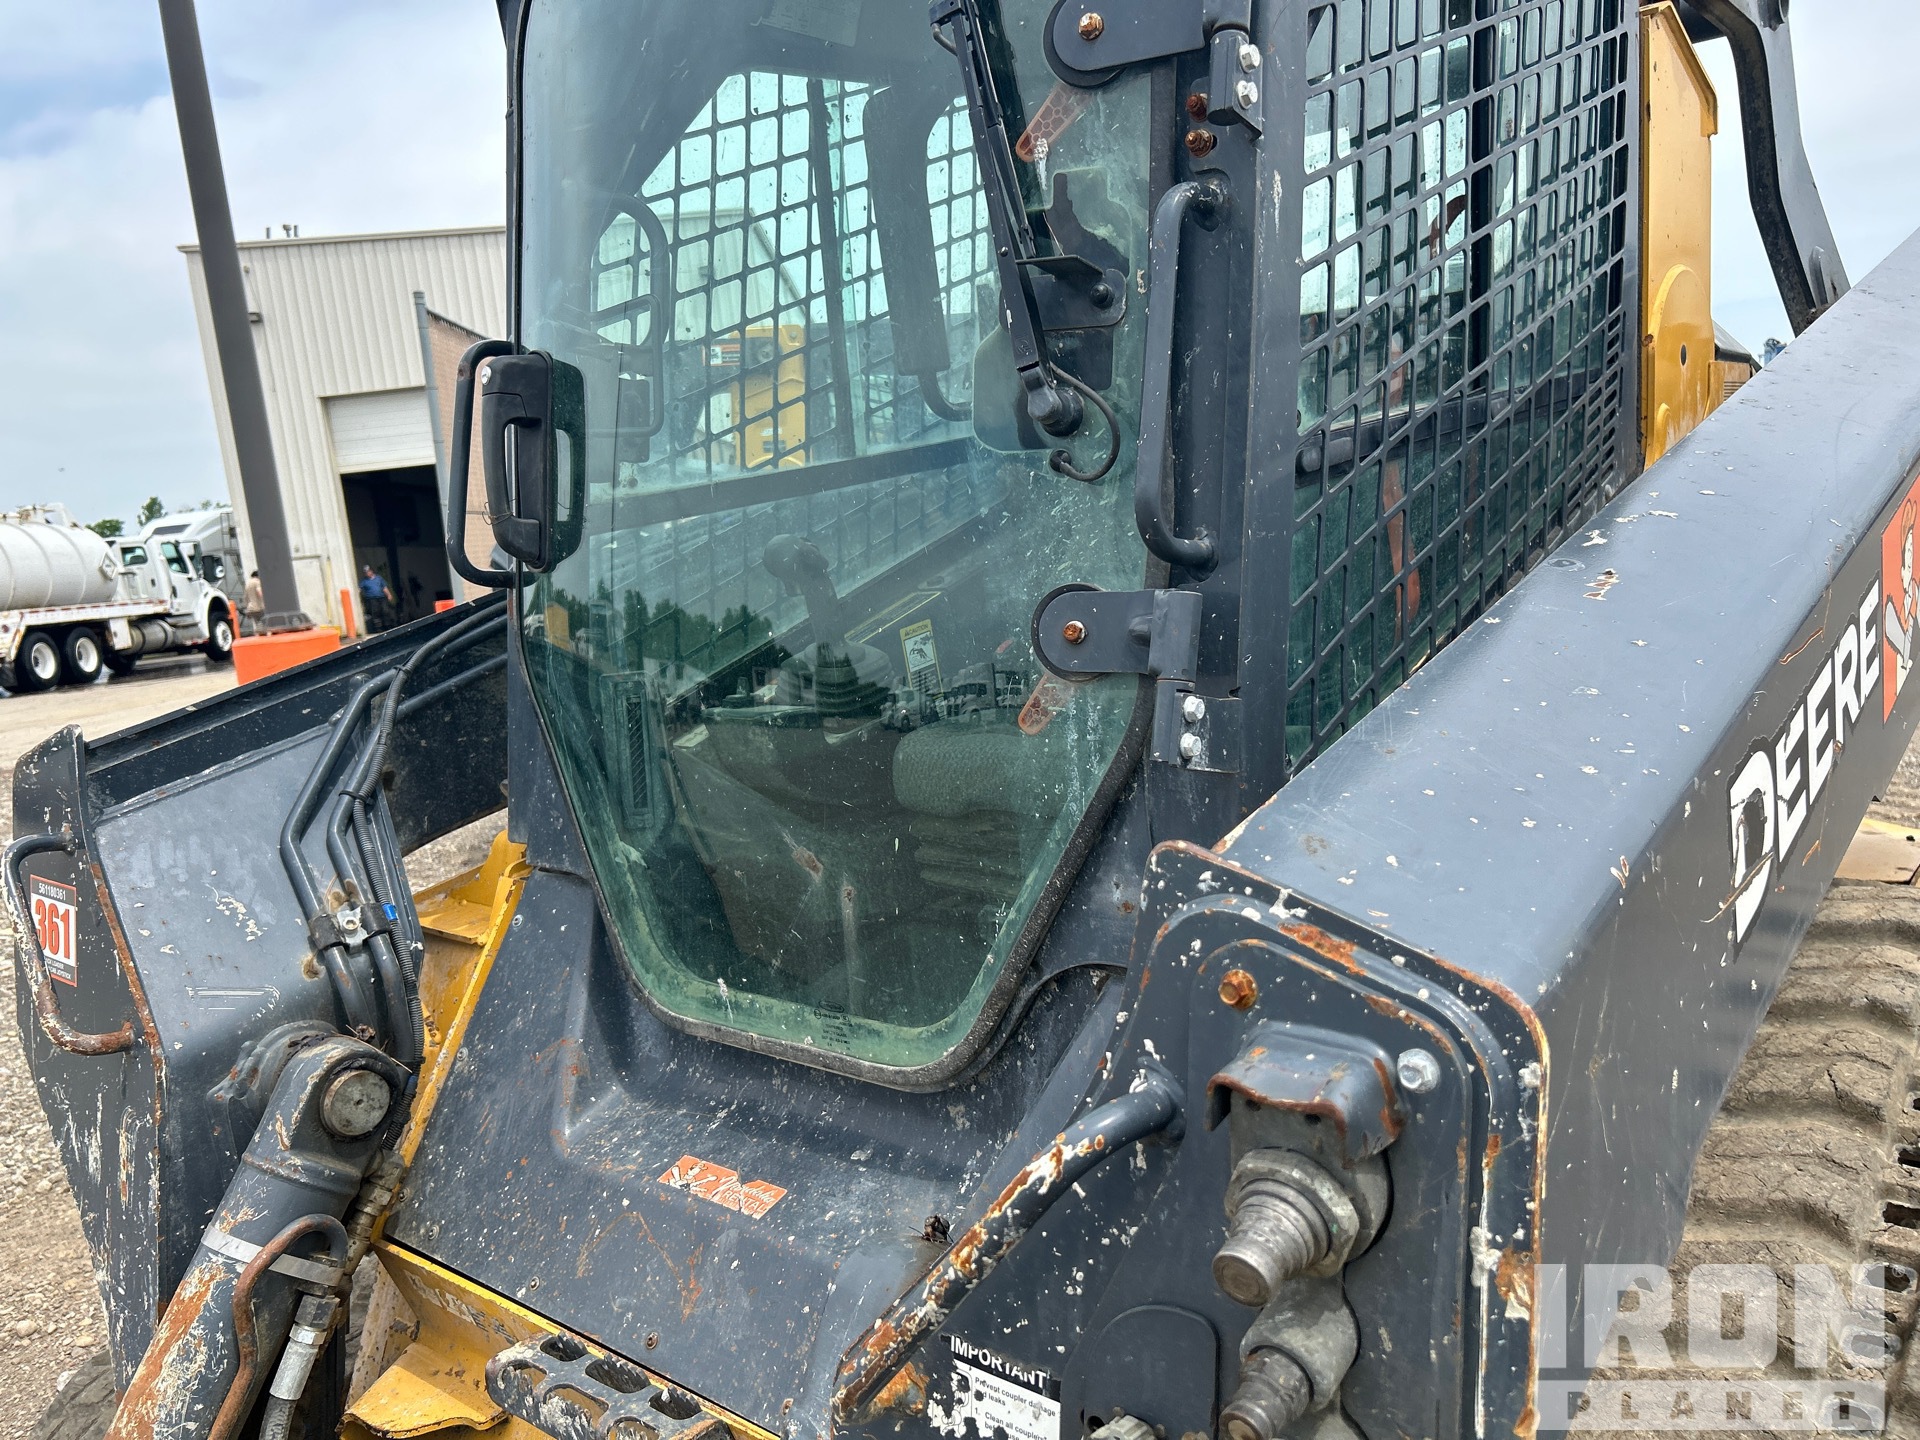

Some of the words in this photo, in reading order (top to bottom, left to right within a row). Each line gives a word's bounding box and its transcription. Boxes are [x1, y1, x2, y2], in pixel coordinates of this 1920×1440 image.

[1730, 580, 1880, 943] DEERE
[35, 899, 70, 959] 361
[975, 1376, 1001, 1393] Prevent
[1001, 1389, 1027, 1405] coupler
[988, 1393, 1006, 1406] leaks
[985, 1411, 1004, 1425] Clean
[1005, 1421, 1013, 1430] all
